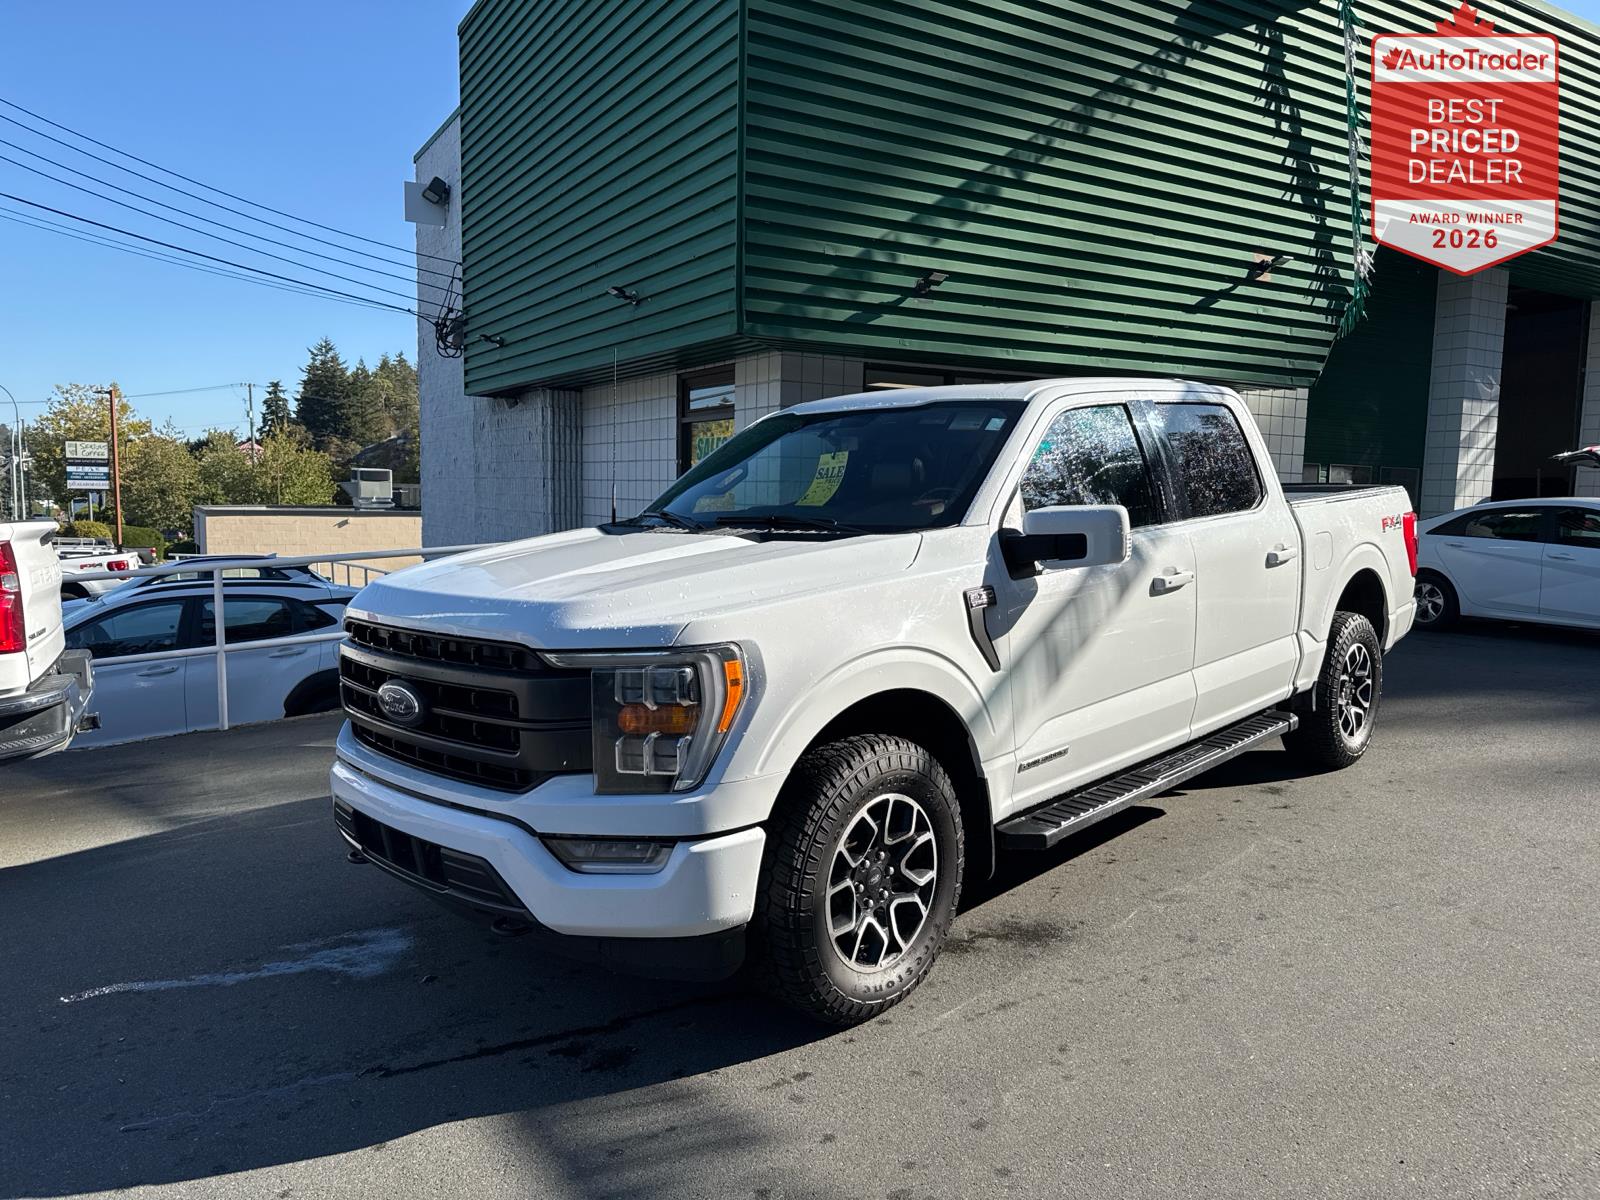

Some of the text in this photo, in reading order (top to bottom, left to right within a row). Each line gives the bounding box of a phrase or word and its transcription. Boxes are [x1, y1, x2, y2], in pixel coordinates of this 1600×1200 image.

[816, 465, 845, 480] SALE
[1381, 513, 1402, 533] FX4
[384, 691, 408, 714] Ford
